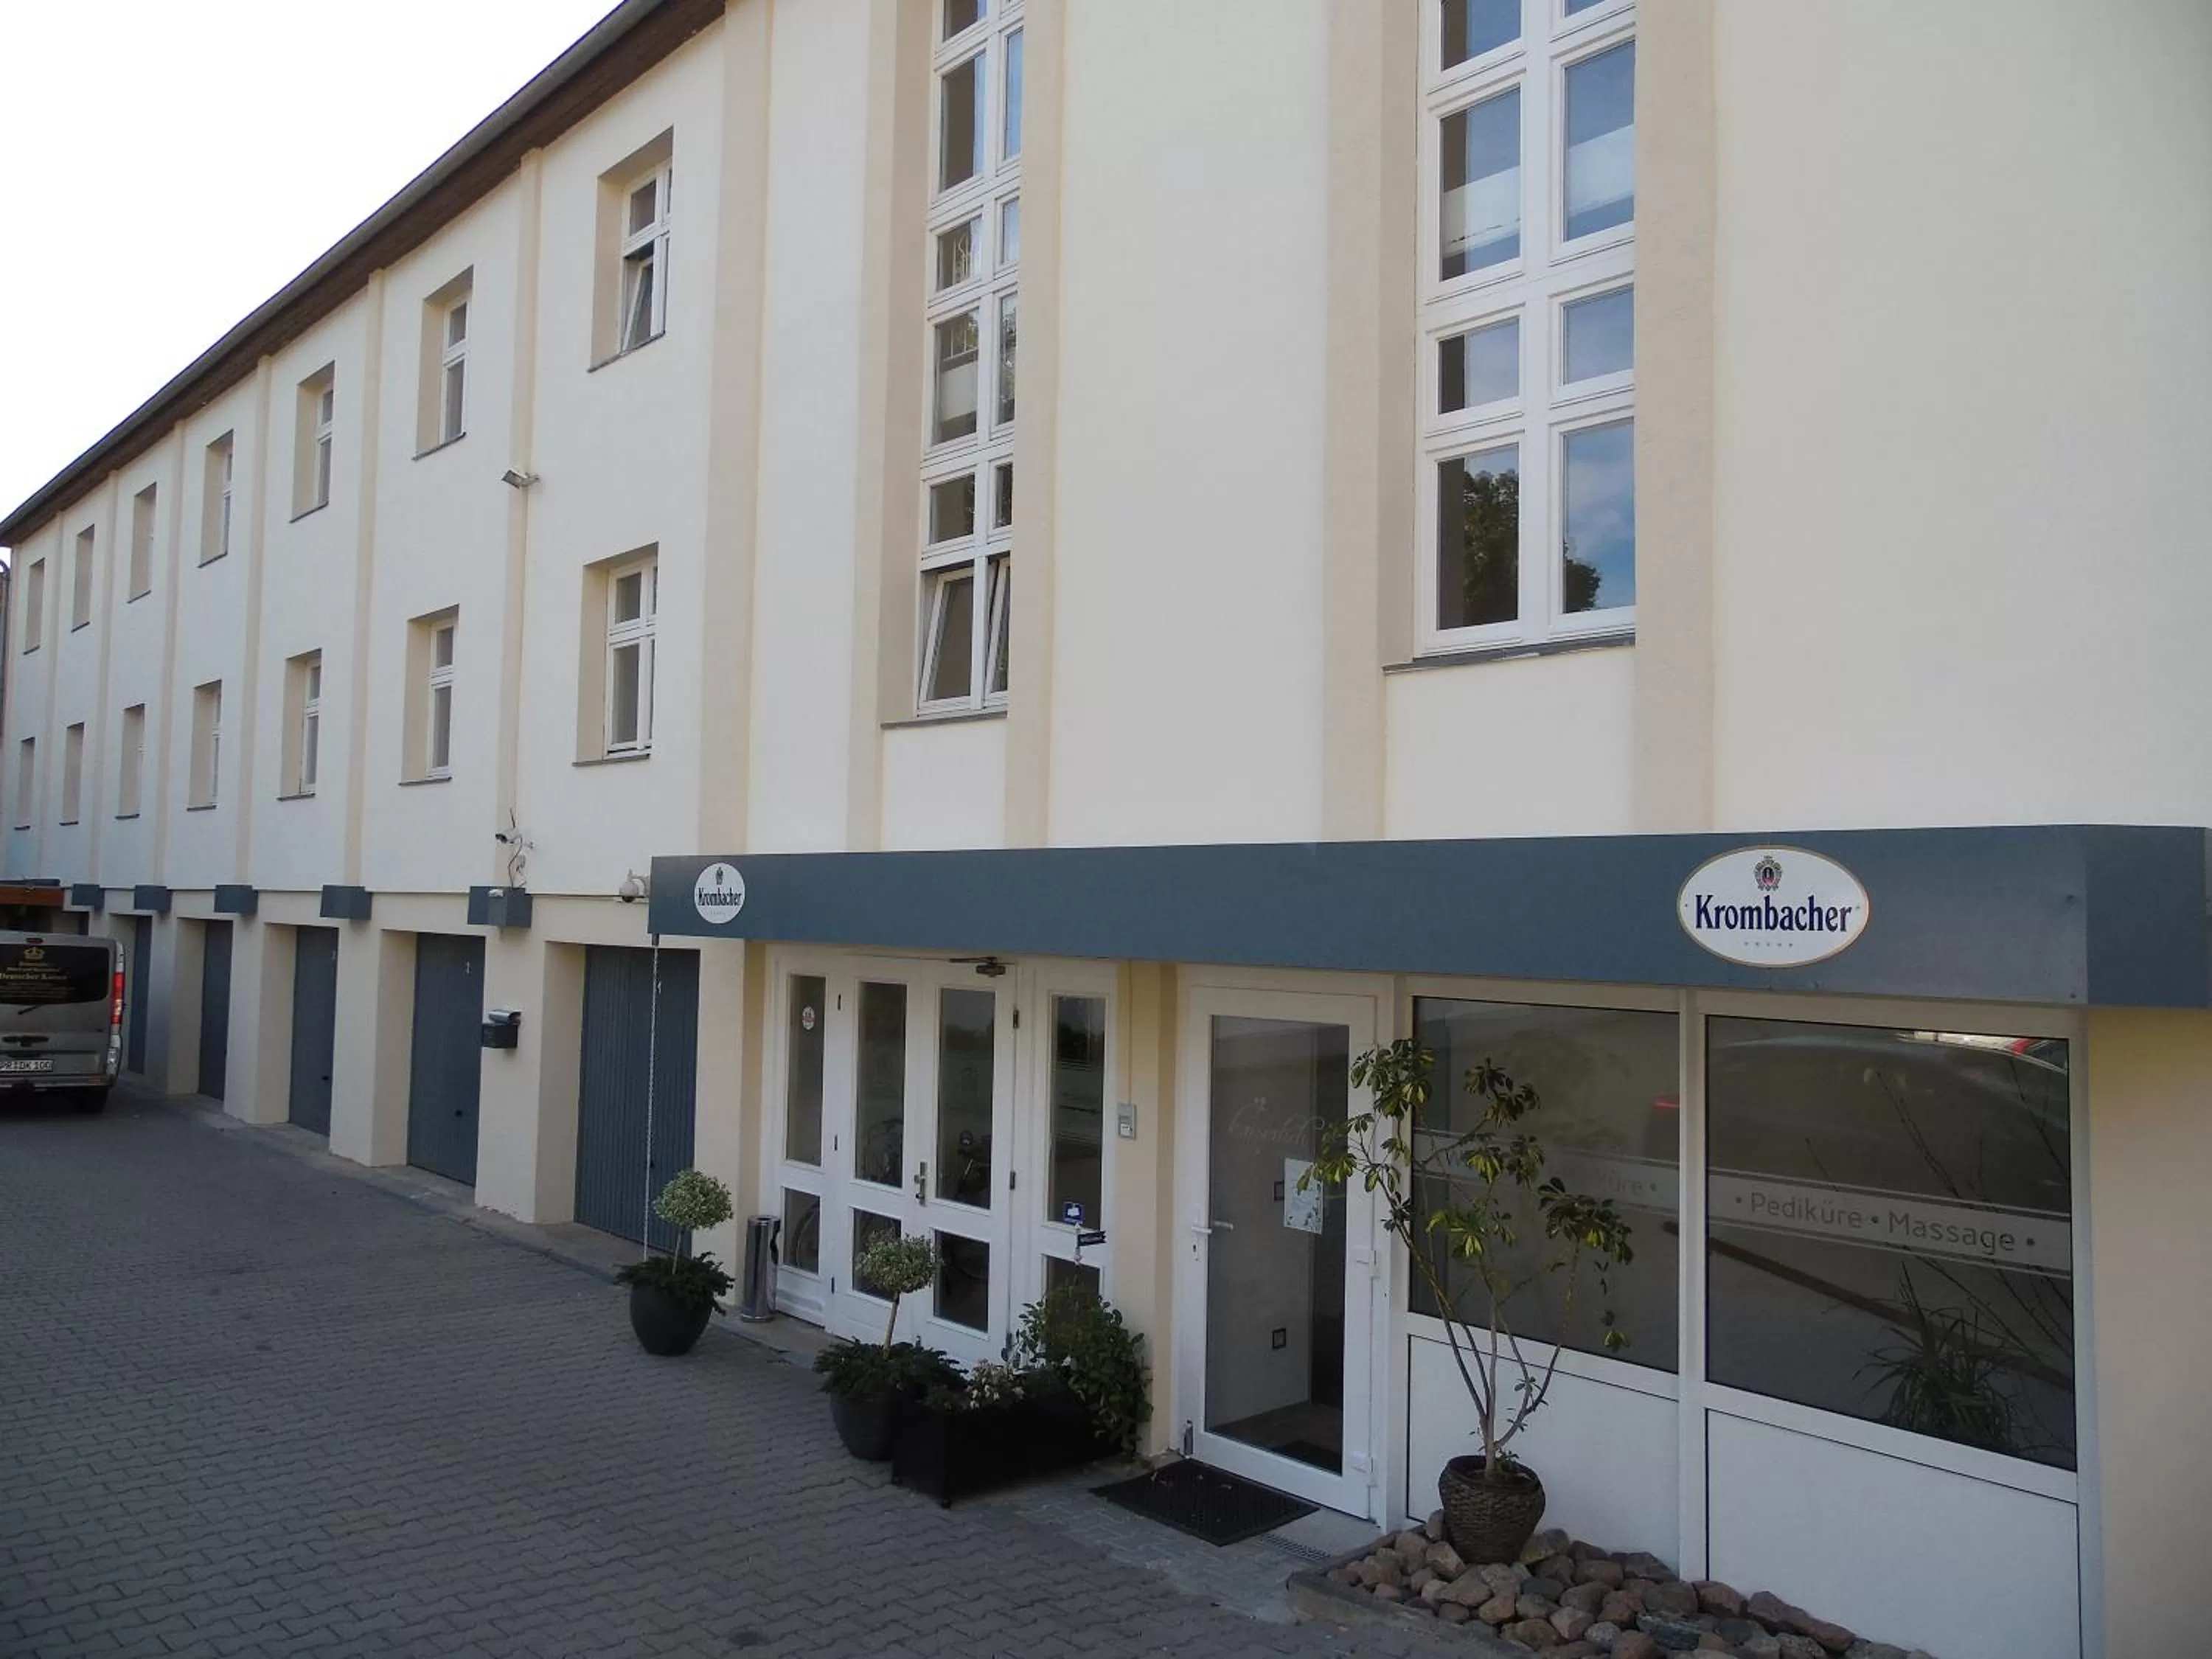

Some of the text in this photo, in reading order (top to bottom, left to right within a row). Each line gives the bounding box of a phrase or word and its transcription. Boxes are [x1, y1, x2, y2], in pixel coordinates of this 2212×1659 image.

[698, 887, 742, 906] Krombacher
[1696, 894, 1852, 933] Krombacher
[1750, 1191, 2015, 1255] Pediküre Massage
